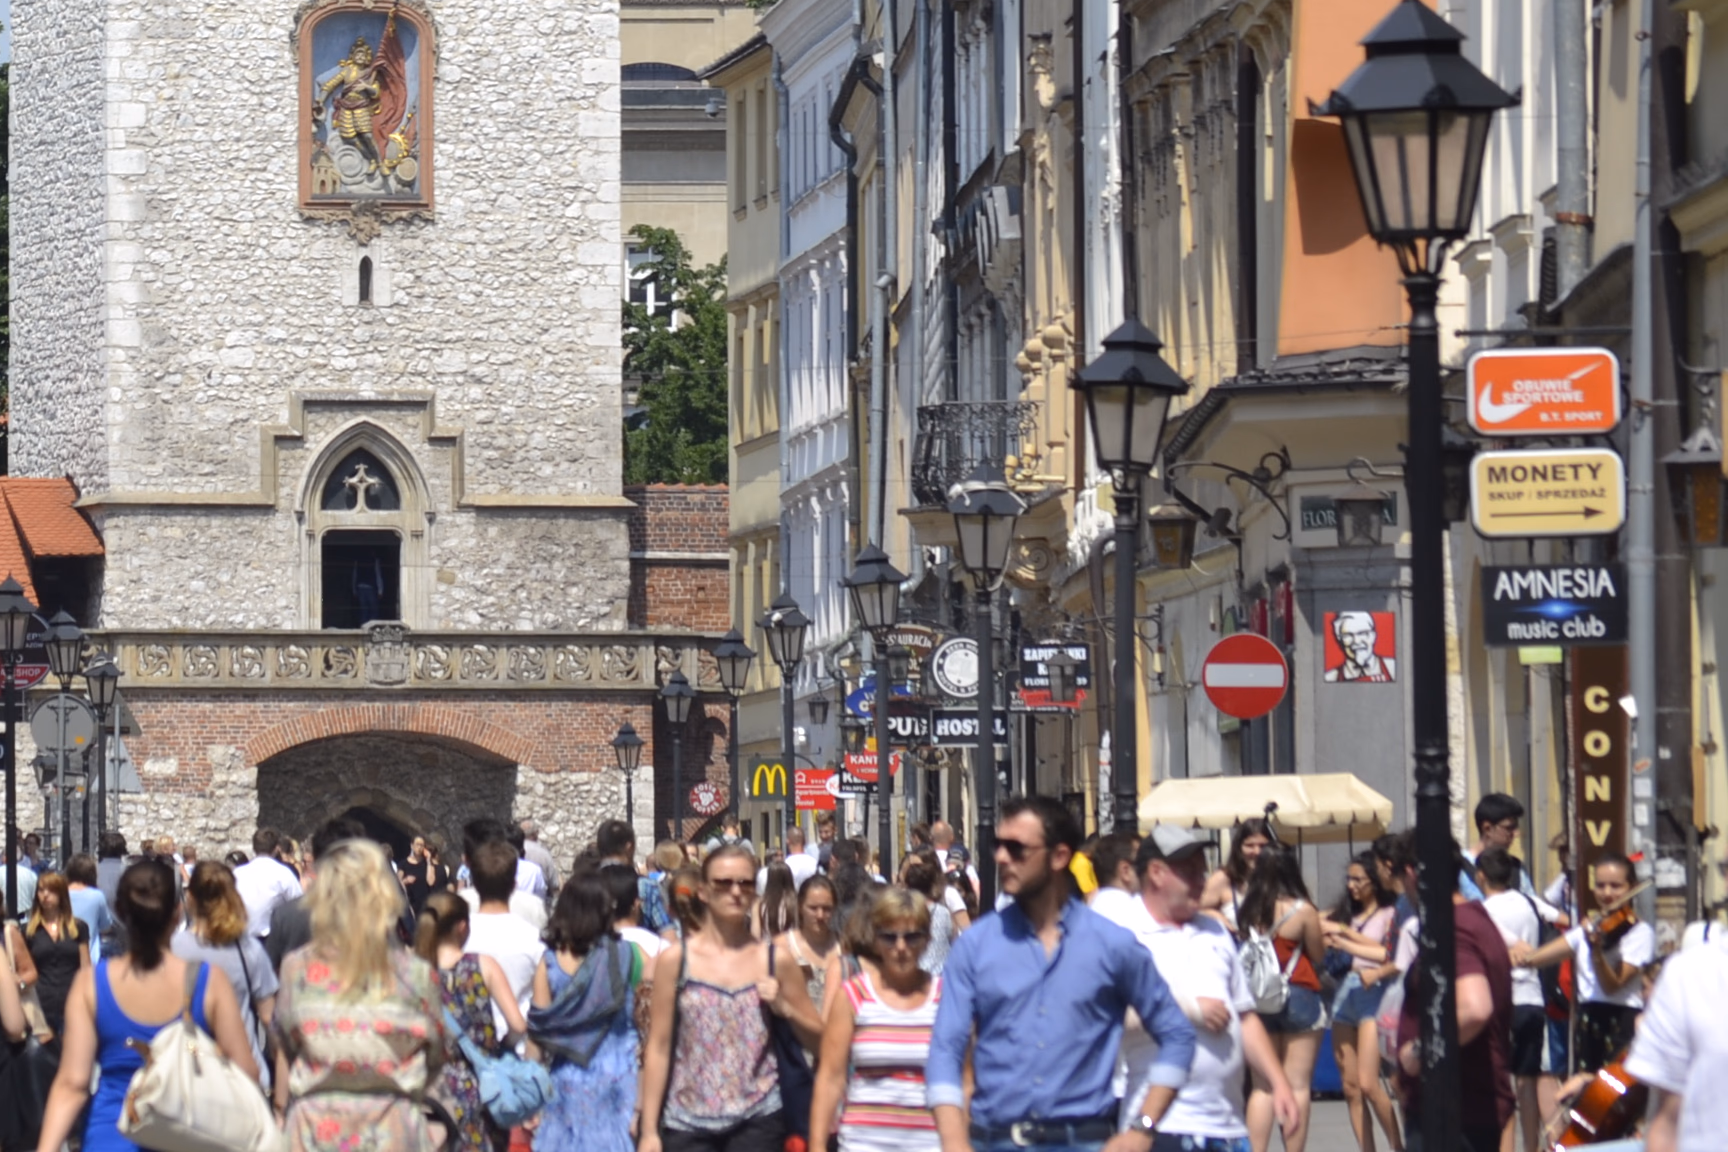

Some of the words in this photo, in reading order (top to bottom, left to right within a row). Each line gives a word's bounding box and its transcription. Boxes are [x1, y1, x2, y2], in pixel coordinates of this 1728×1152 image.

[1512, 379, 1572, 393] OBUWIE
[1502, 390, 1585, 405] SPORTOWE
[1539, 412, 1562, 423] B.T.
[1564, 411, 1604, 422] SPORT
[1487, 463, 1603, 485] MONETY
[1488, 490, 1525, 502] SKUP
[1536, 487, 1607, 501] SPRZEDAŻ
[1493, 568, 1616, 601] AMNESIA
[1507, 619, 1559, 640] music
[1562, 614, 1606, 638] club
[850, 754, 894, 766] KANTR
